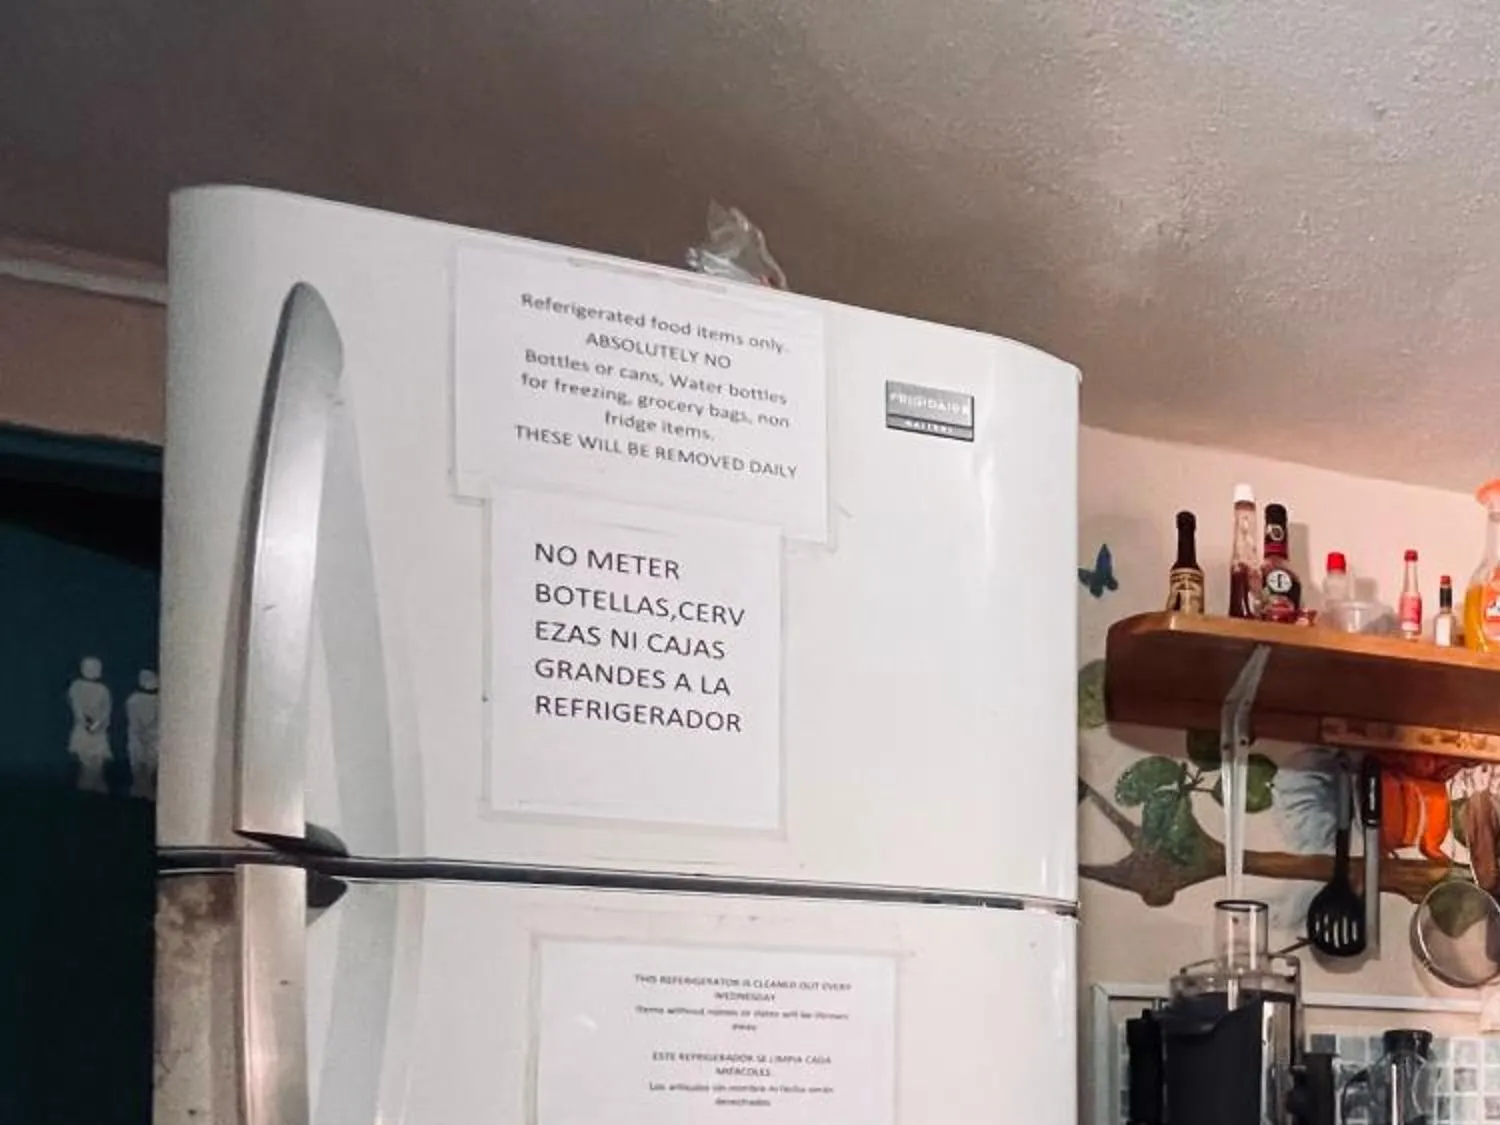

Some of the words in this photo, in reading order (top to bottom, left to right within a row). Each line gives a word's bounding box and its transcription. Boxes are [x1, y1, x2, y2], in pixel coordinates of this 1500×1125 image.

[520, 293, 645, 328] Referigerated
[651, 314, 691, 336] food
[697, 324, 744, 347] items
[586, 332, 699, 363] ABSOLUTELY
[704, 352, 732, 369] NO
[525, 349, 589, 373] Bottles
[595, 362, 612, 375] or
[619, 366, 664, 386] cans,
[669, 373, 723, 395] Water
[728, 383, 788, 406] bottles
[521, 373, 548, 390] for
[637, 395, 704, 418] grocery
[757, 413, 789, 429] non
[604, 410, 657, 432] fridge
[515, 424, 572, 447] THESE
[578, 433, 622, 454] WILL
[628, 440, 649, 458] BE
[655, 446, 744, 472] REMOVED
[749, 461, 798, 480] DAILY
[534, 542, 577, 567] NO
[587, 549, 680, 580] METER
[535, 583, 746, 628] BOTELLAS,CERV
[535, 620, 602, 647] EZAS
[610, 628, 638, 649] NI
[647, 633, 726, 660] CAJAS
[534, 657, 666, 690] GRANDES
[673, 672, 692, 692] A
[700, 675, 731, 697] LA
[535, 695, 742, 733] REFRIGERADOR
[799, 981, 819, 990] OUT
[652, 1051, 675, 1061] ESTE
